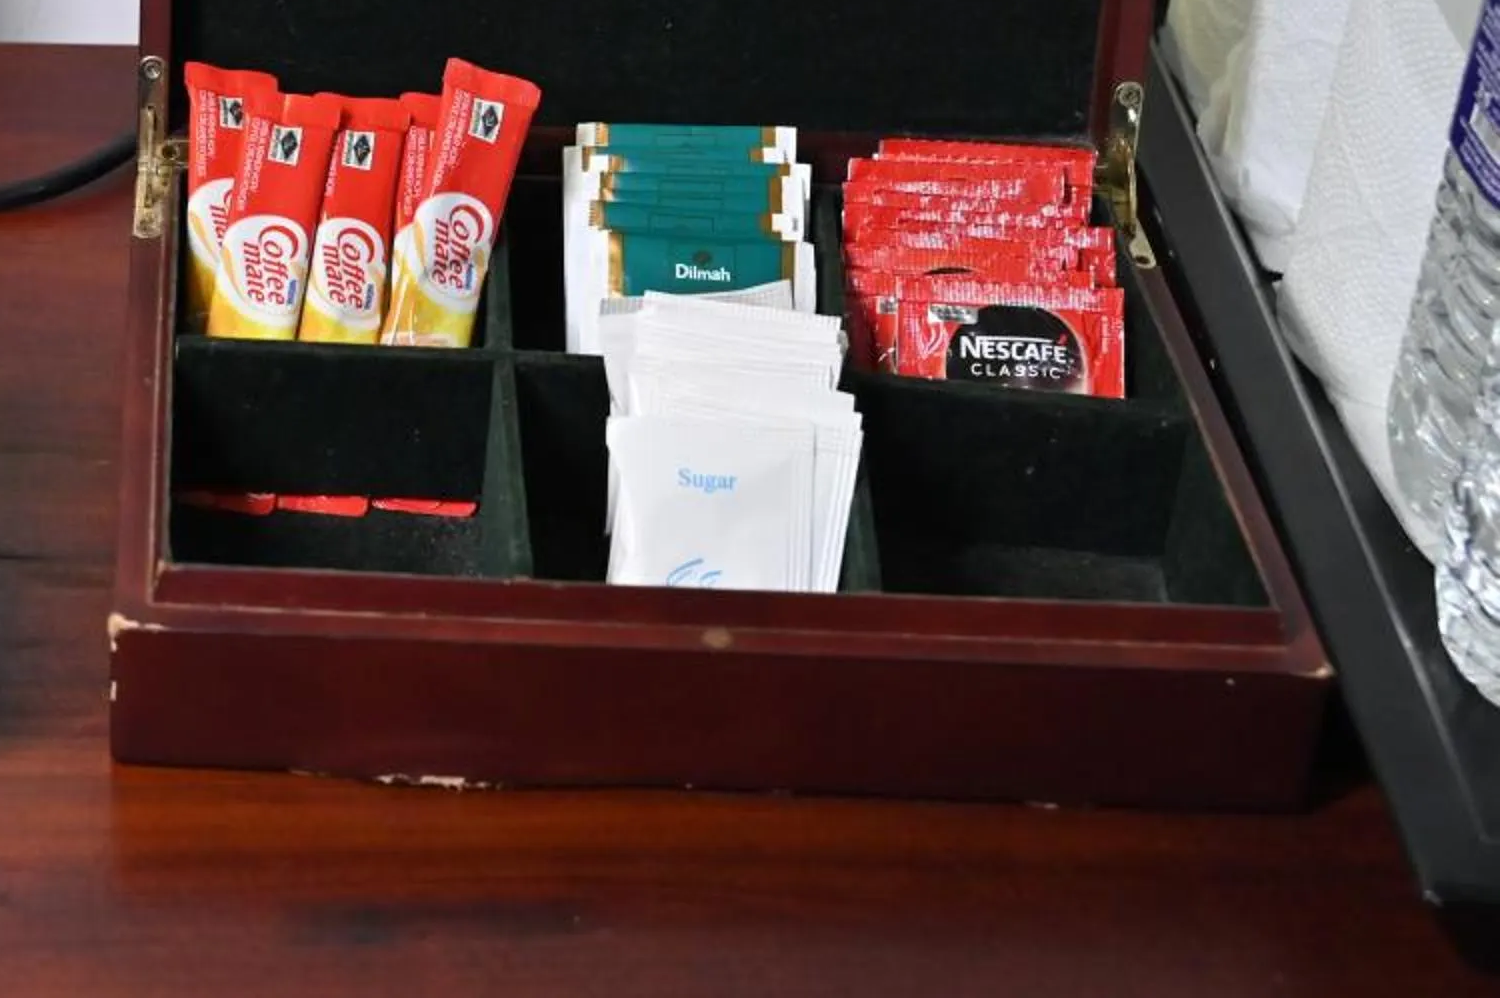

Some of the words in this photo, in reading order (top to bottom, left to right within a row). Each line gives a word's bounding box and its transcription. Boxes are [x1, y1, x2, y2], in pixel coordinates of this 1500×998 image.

[243, 241, 266, 305] mate
[258, 224, 299, 306] Coffee
[322, 243, 347, 305] mate
[337, 227, 375, 310] Coffee
[432, 217, 449, 285] mate
[449, 204, 485, 290] Coffee
[675, 263, 731, 283] Dilmah
[970, 362, 1061, 380] CLASSIC
[676, 467, 738, 495] Sugar
